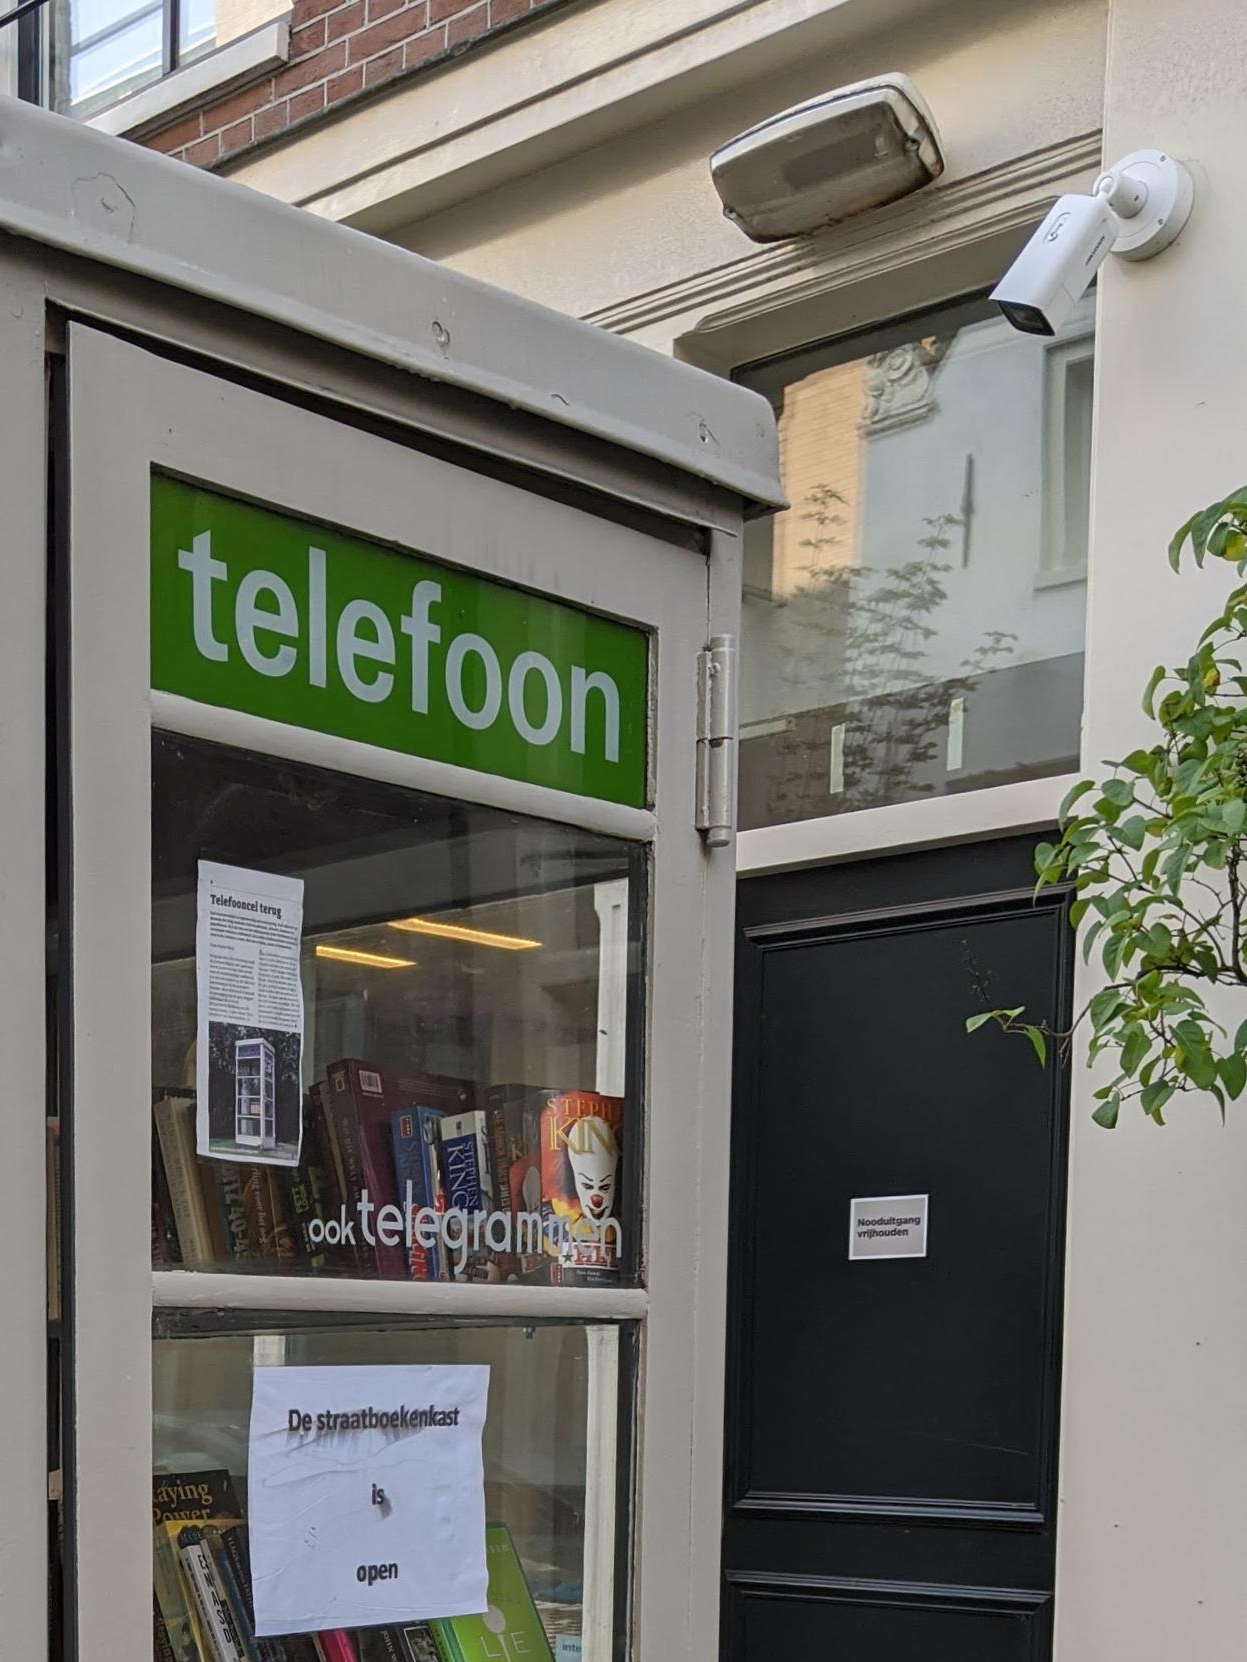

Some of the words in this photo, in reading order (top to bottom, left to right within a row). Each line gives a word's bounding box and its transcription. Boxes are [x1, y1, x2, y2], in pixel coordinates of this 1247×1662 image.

[177, 529, 621, 764] telefoon
[210, 894, 259, 913] Telefooncel
[260, 904, 282, 920] terug
[462, 1141, 479, 1209] STEPHEN
[308, 1204, 357, 1245] ook
[357, 1179, 623, 1275] telegrammen
[857, 1217, 921, 1227] Nooduitgang
[857, 1228, 909, 1239] vrijhouden
[288, 1409, 313, 1432] De
[316, 1404, 460, 1431] straatboekenkast
[371, 1484, 385, 1506] is
[355, 1559, 399, 1587] open
